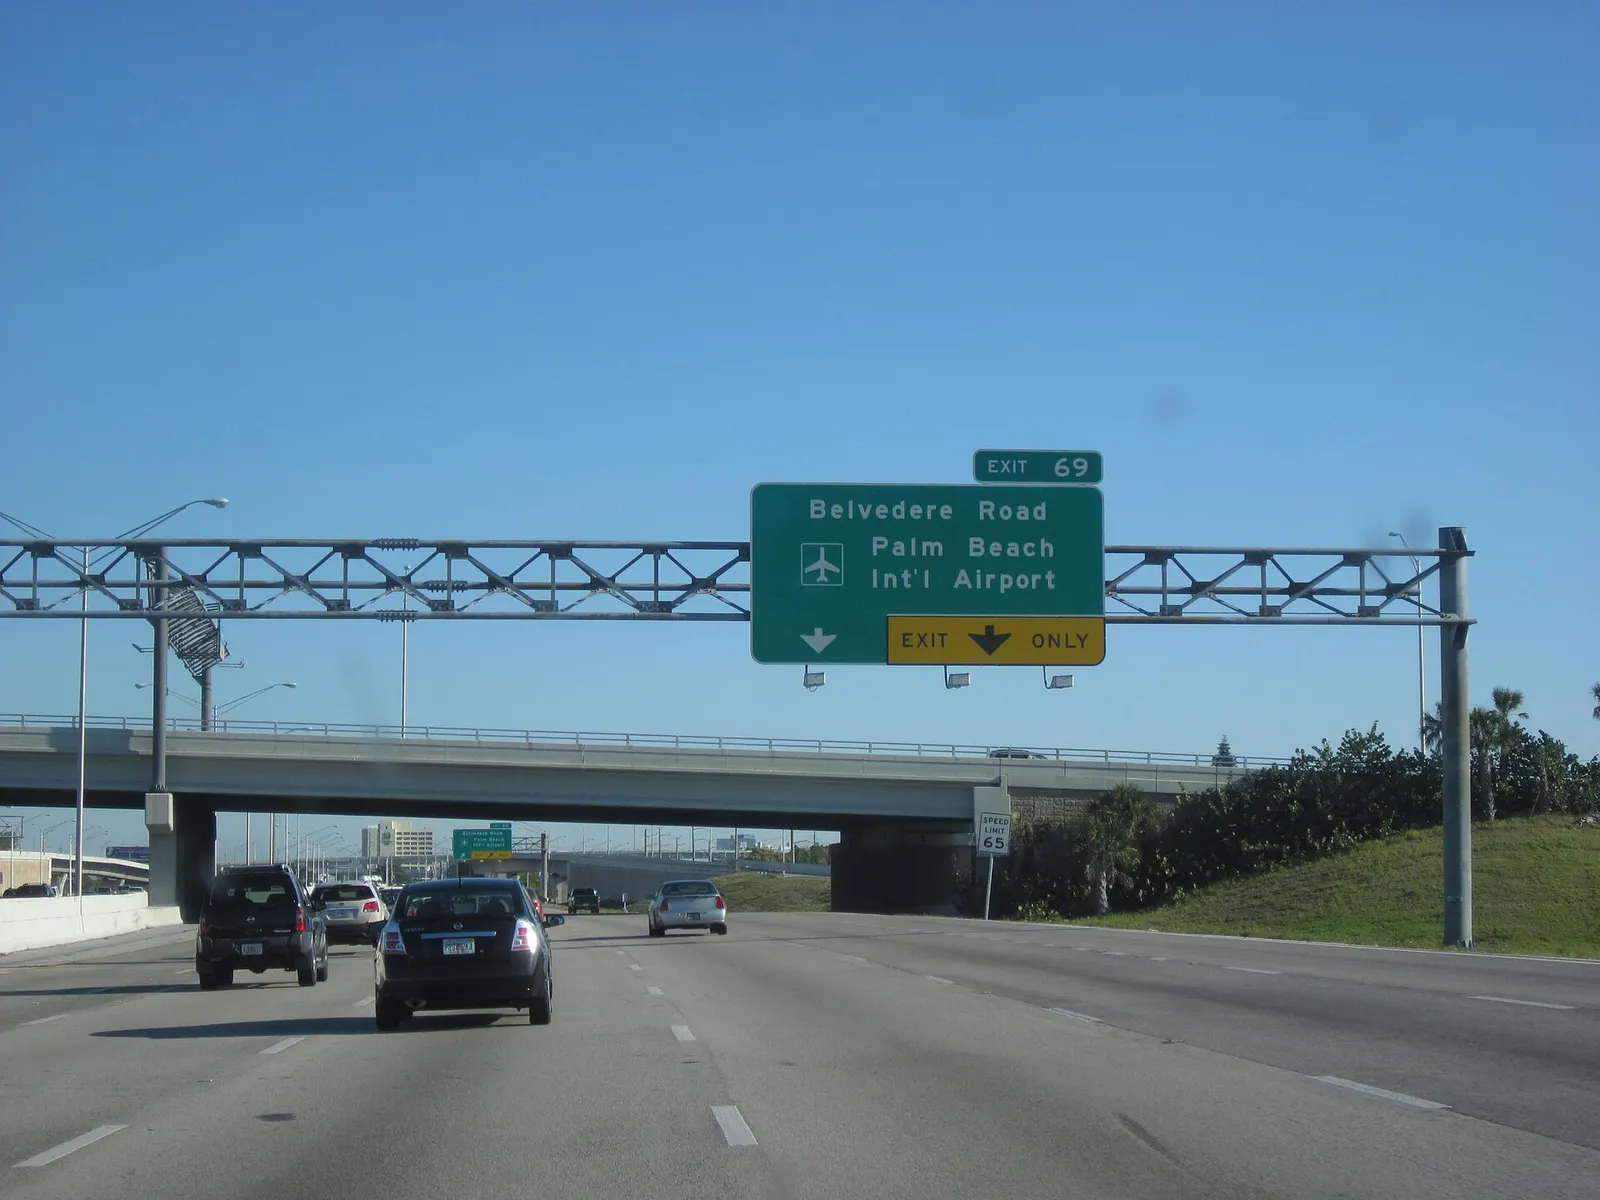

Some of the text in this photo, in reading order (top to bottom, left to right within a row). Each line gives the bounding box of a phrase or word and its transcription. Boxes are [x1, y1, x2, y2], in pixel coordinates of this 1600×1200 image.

[987, 456, 1089, 478] EXIT 69
[809, 498, 1047, 521] Belvedere Road
[872, 536, 1054, 558] Palm Beach
[872, 568, 1056, 594] Int'l Airport
[902, 632, 1089, 649] EXIT ONLY
[983, 817, 1009, 825] SPEED
[984, 837, 1004, 849] 65
